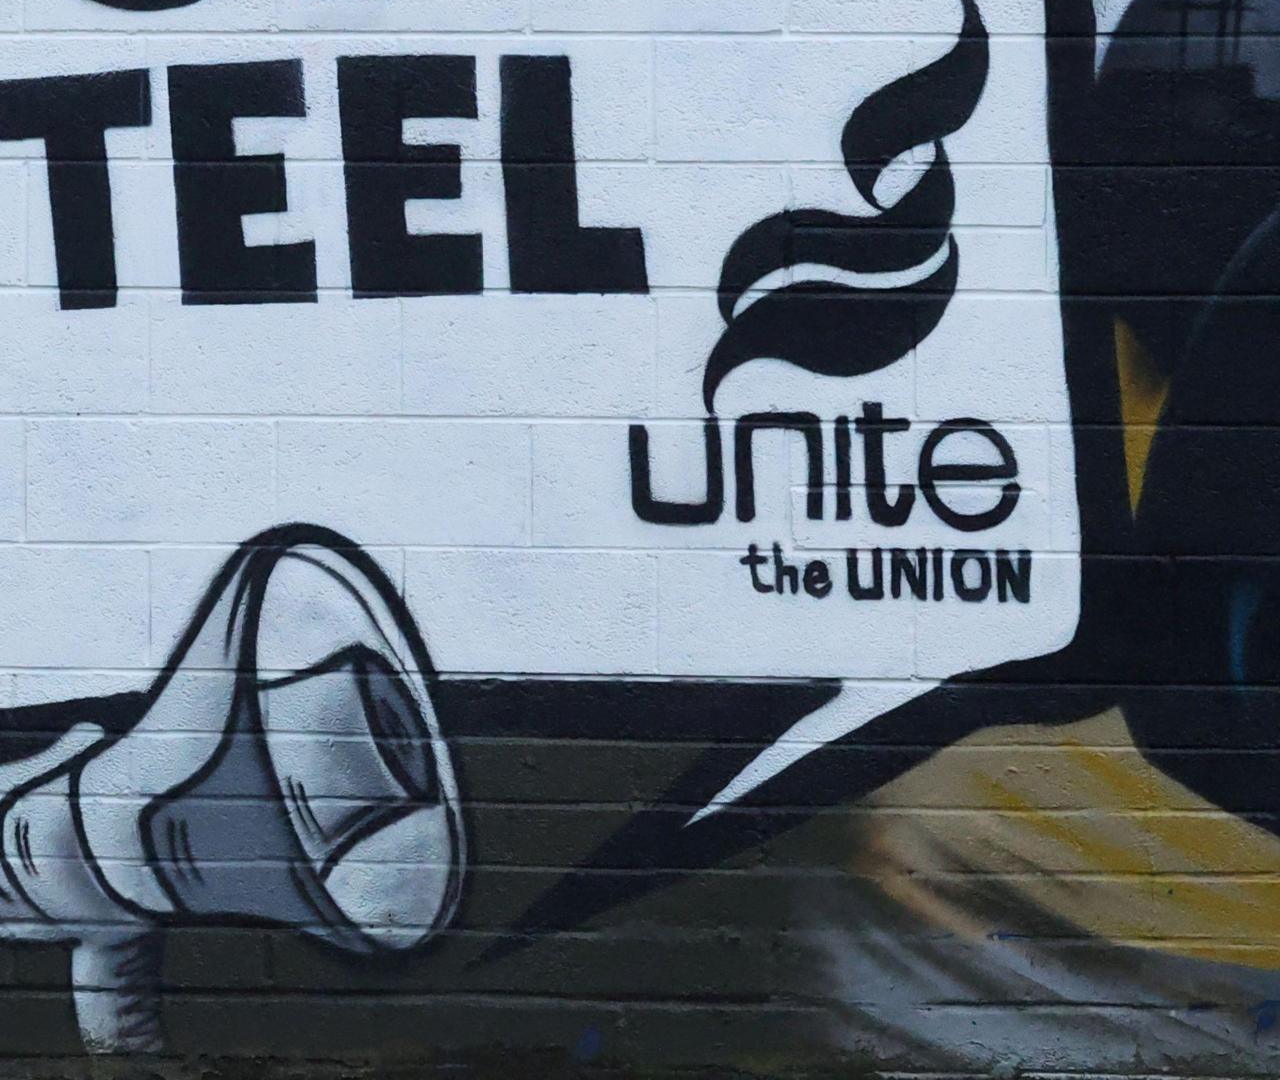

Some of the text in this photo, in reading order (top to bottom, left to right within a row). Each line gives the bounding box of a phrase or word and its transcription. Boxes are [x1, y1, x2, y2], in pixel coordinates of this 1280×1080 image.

[628, 402, 1022, 533] unite
[739, 542, 1033, 604] the UNION
